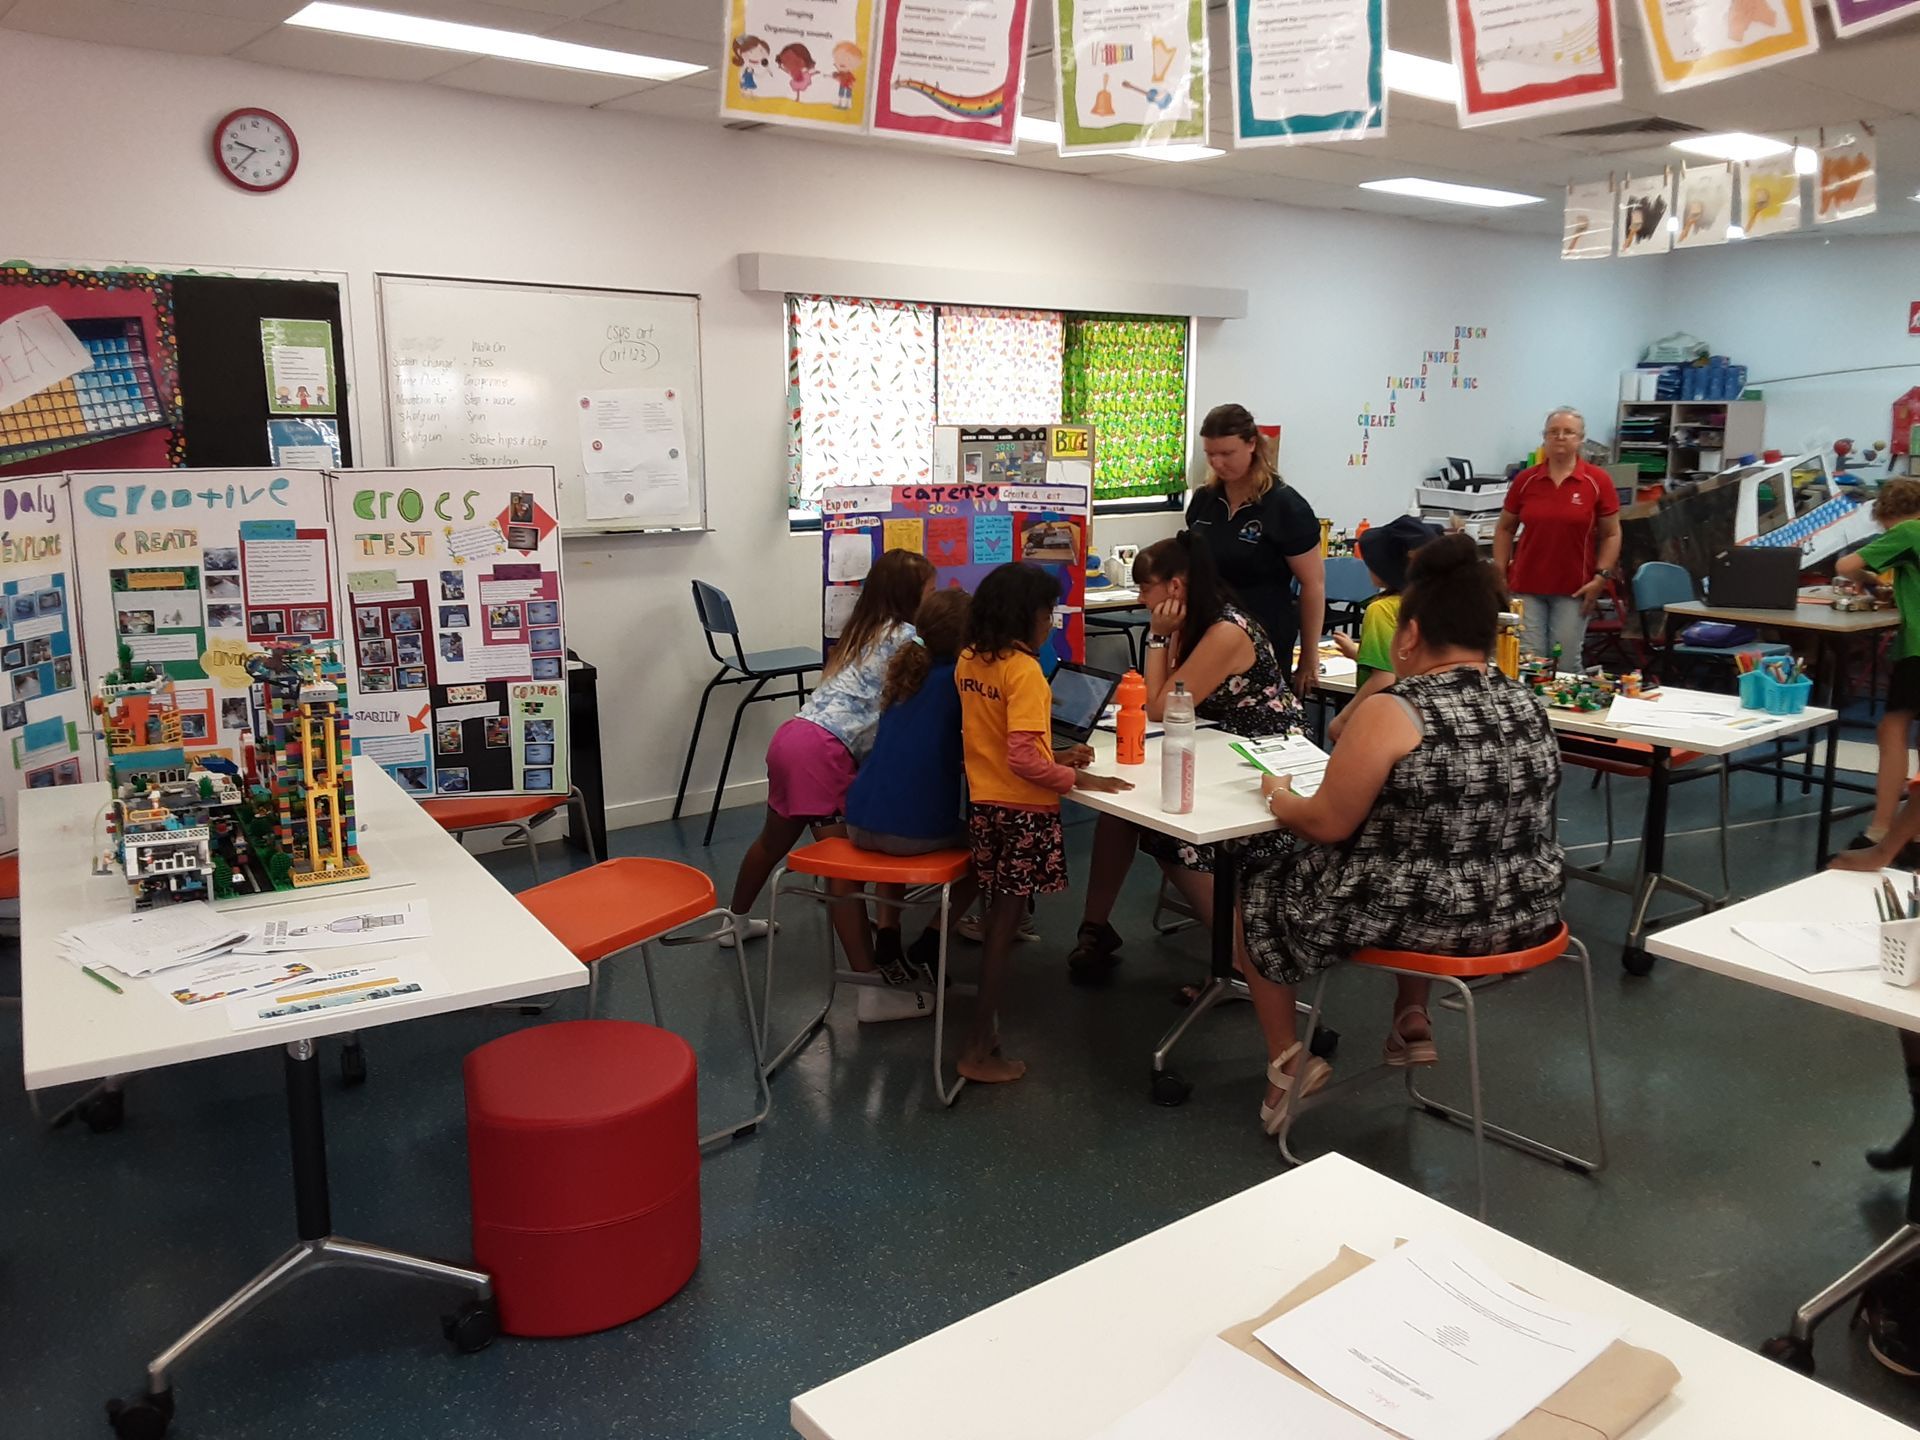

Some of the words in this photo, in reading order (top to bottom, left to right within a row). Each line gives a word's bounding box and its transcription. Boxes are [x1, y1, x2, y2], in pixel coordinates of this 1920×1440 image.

[1387, 376, 1426, 389] IMAGINE
[1451, 377, 1478, 389] MUSIC
[1358, 414, 1396, 427] CREATE
[1348, 454, 1368, 466] ART
[826, 499, 858, 512] Expore
[928, 504, 958, 515] 2020
[114, 529, 199, 555] CREATE
[355, 531, 432, 556] TEST
[513, 685, 558, 699] CODING
